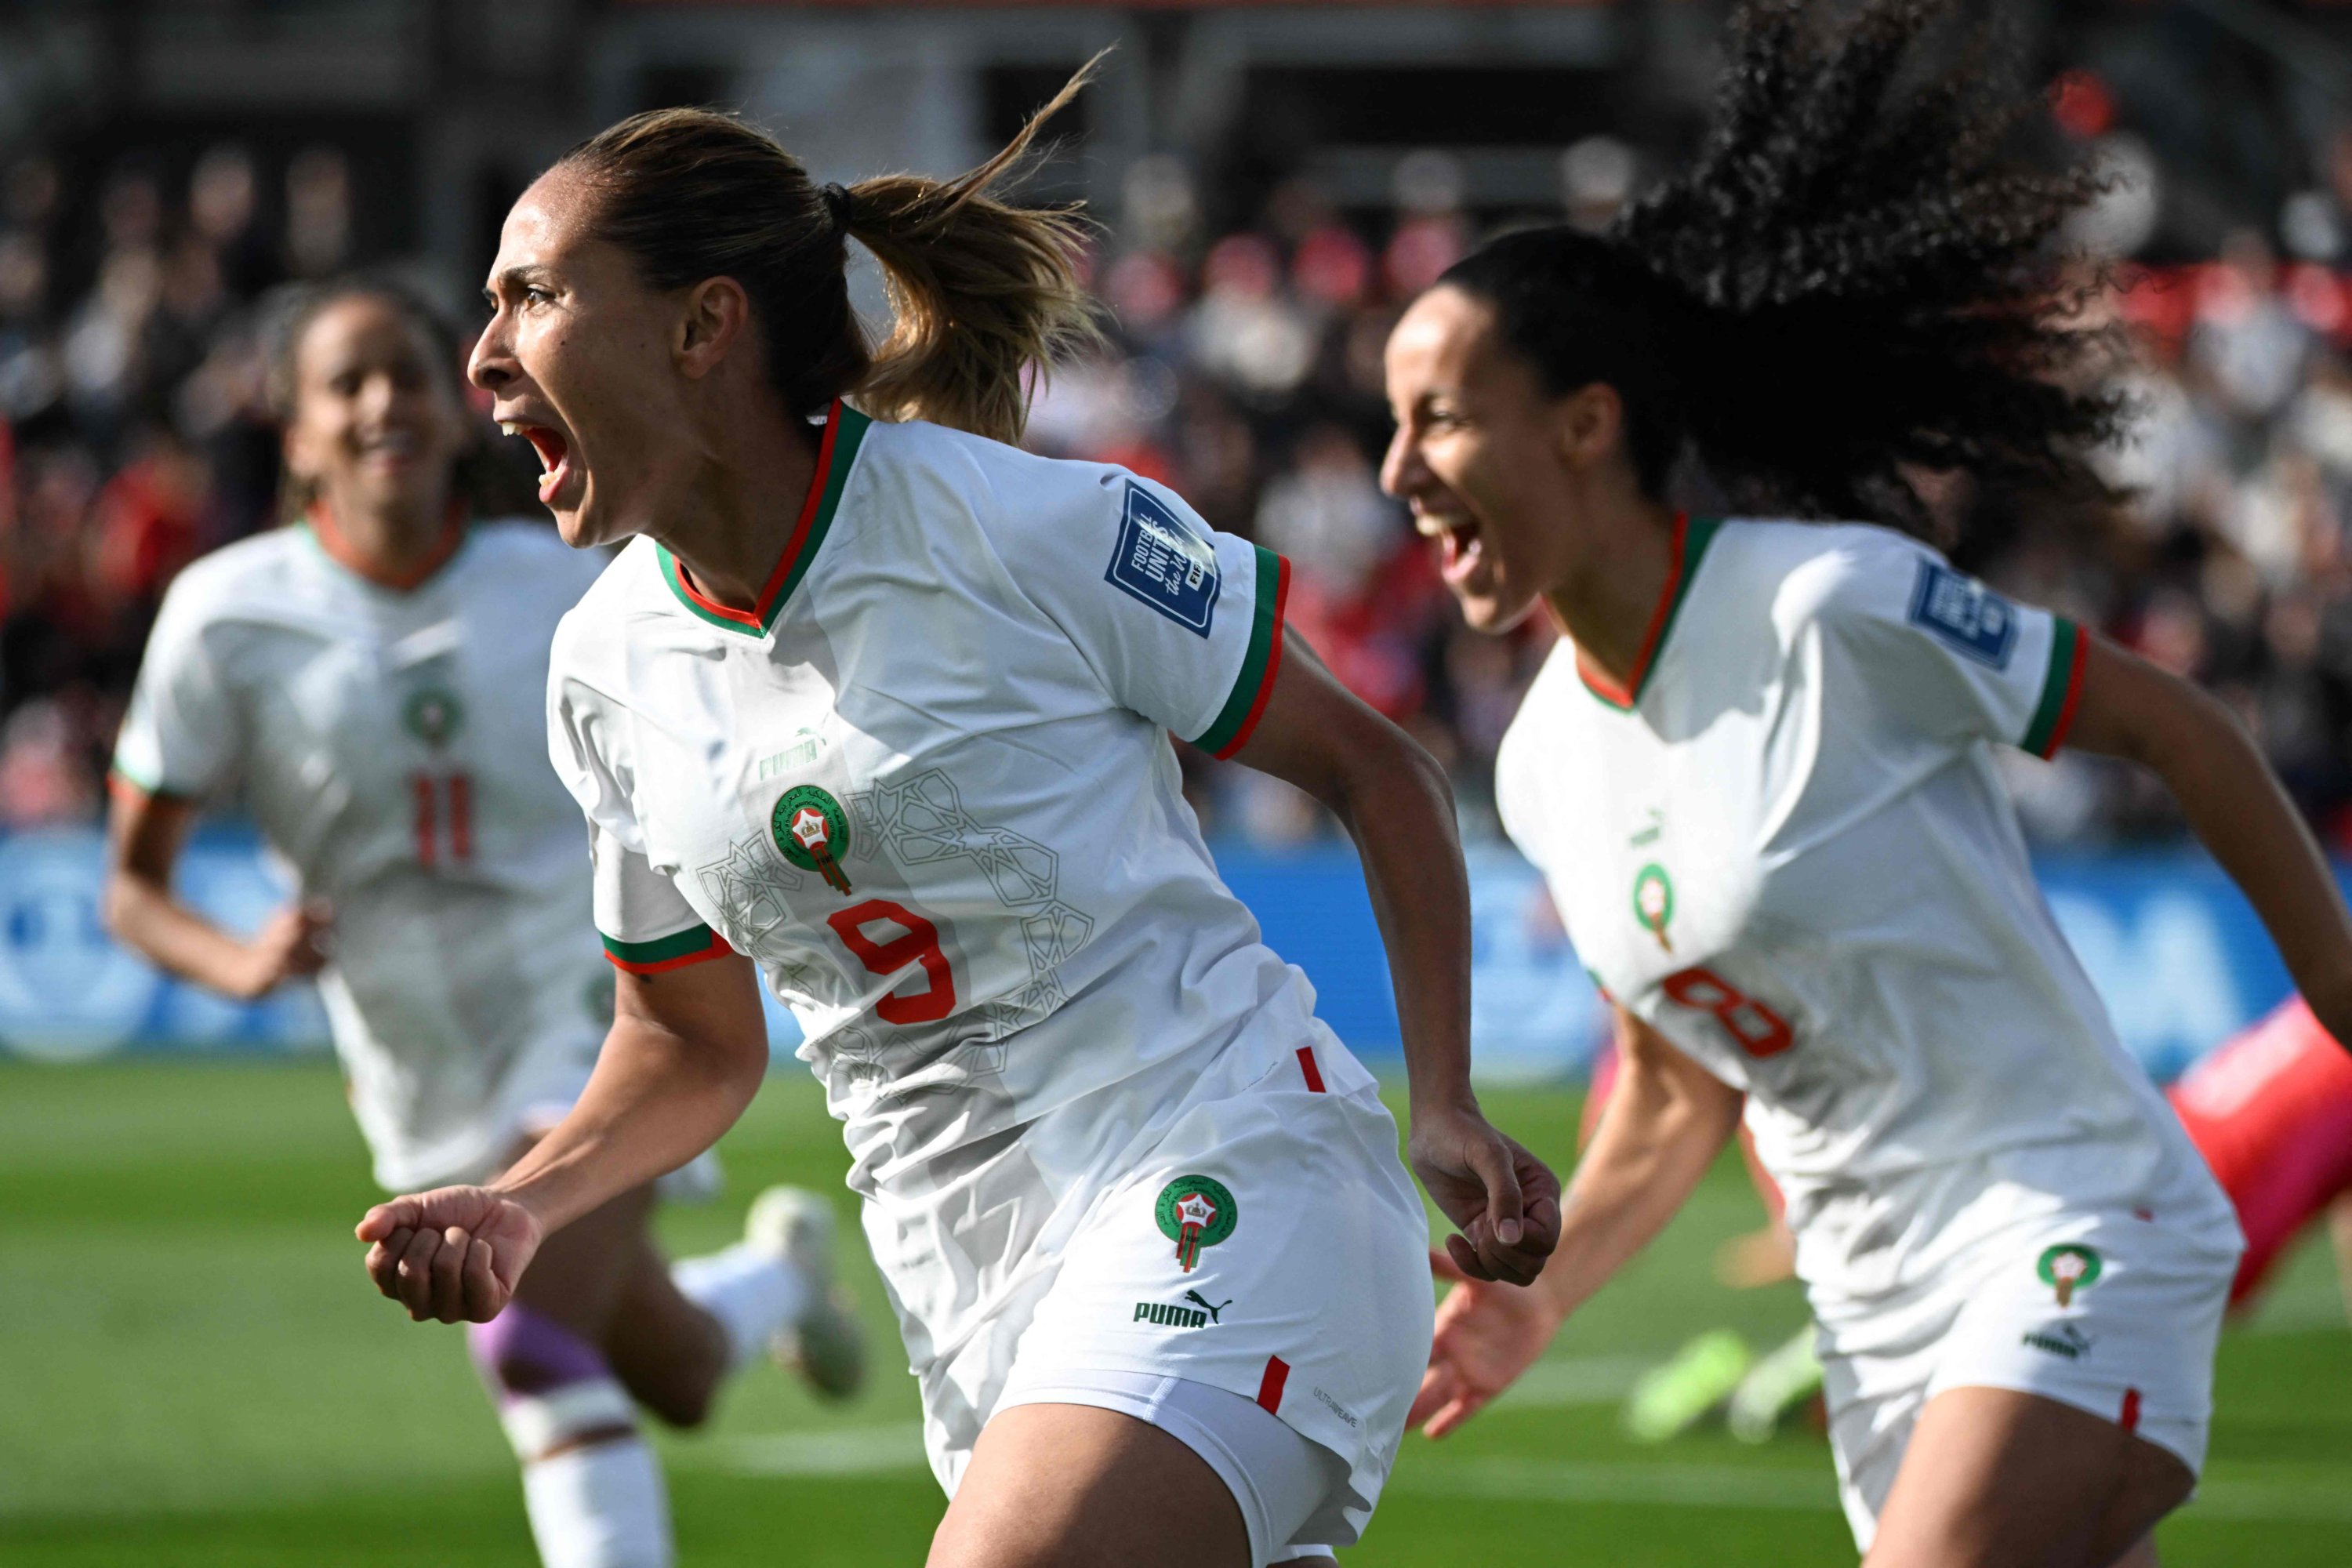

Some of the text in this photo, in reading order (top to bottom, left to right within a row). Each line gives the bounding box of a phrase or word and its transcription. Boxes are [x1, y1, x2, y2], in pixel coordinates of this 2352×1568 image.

[1131, 513, 1154, 572] FOOTBLL
[1145, 521, 1171, 583] UNITS
[1165, 571, 1181, 596] the
[409, 767, 474, 867] 11
[826, 898, 956, 1025] 9
[1661, 967, 1794, 1058] 8
[1134, 1302, 1207, 1329] PUMA
[1313, 1386, 1358, 1428] ULTRAWEAVE
